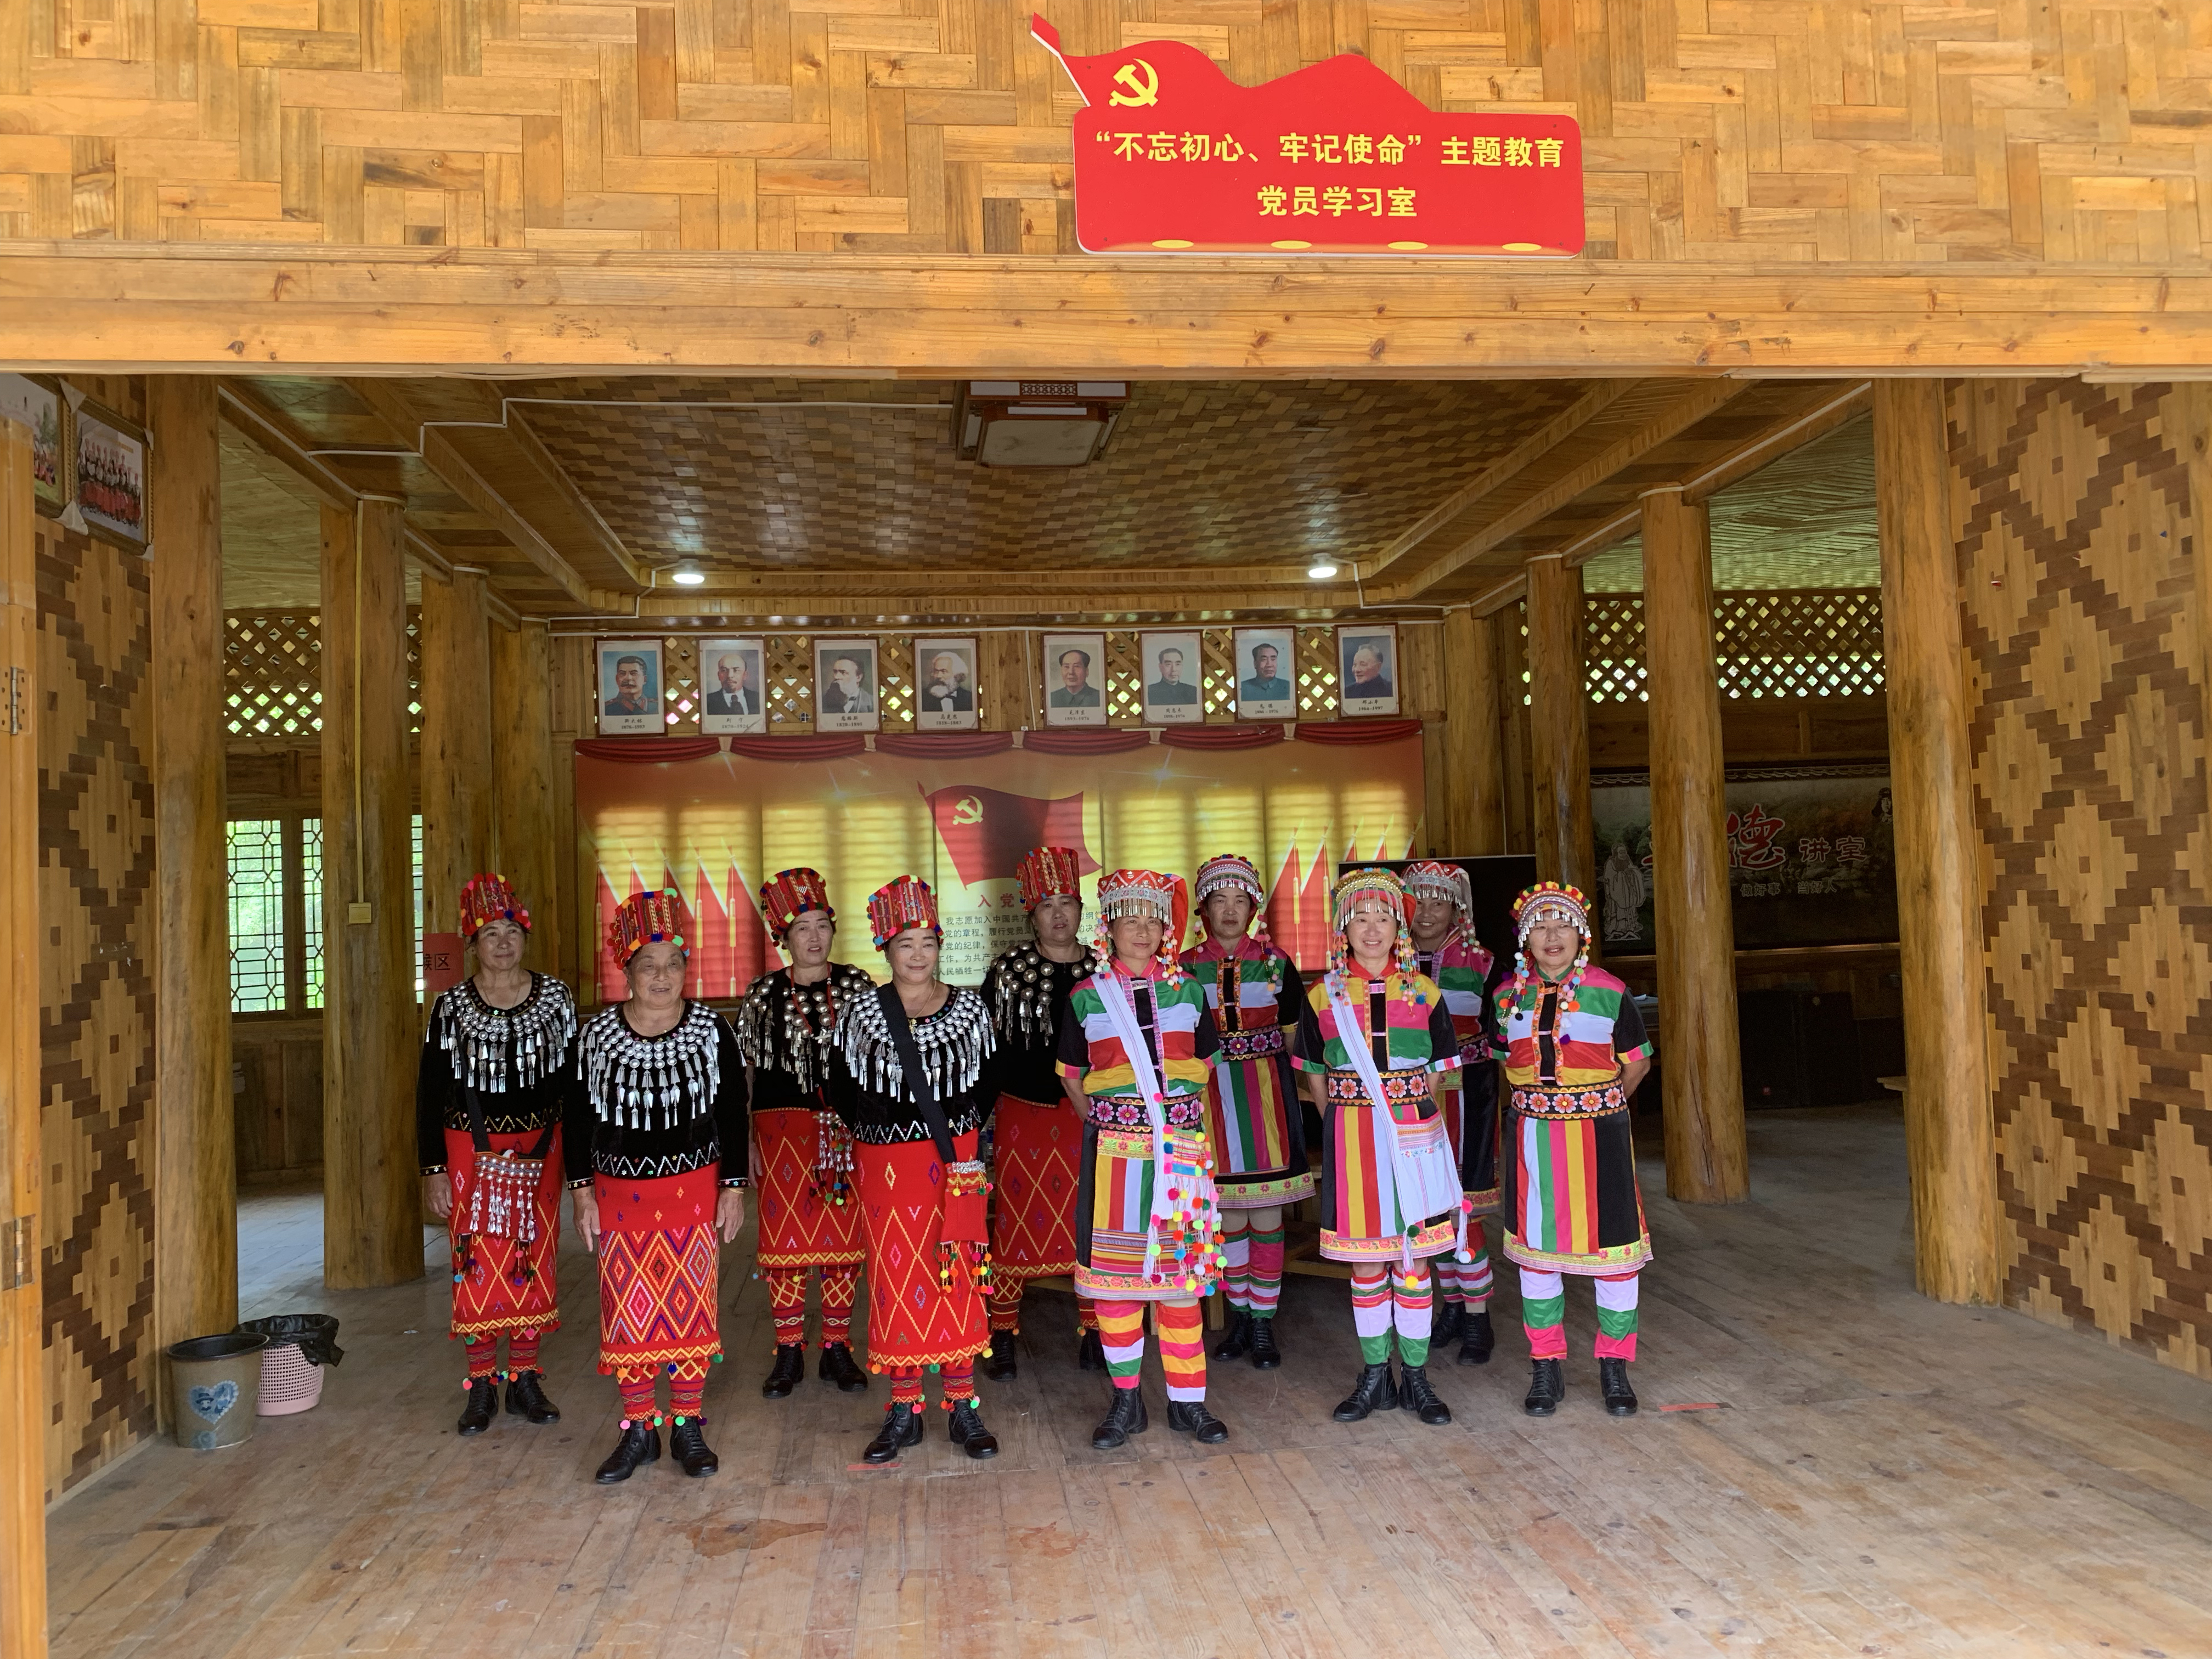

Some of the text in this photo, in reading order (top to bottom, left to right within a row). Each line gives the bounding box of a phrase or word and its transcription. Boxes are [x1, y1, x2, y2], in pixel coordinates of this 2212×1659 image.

[1096, 131, 1564, 168] “不忘初心、牢记使命” 主题教育
[1257, 185, 1417, 217] 党员学习室
[1740, 880, 1837, 897] 做好事 当好人
[978, 893, 1014, 909] 入党
